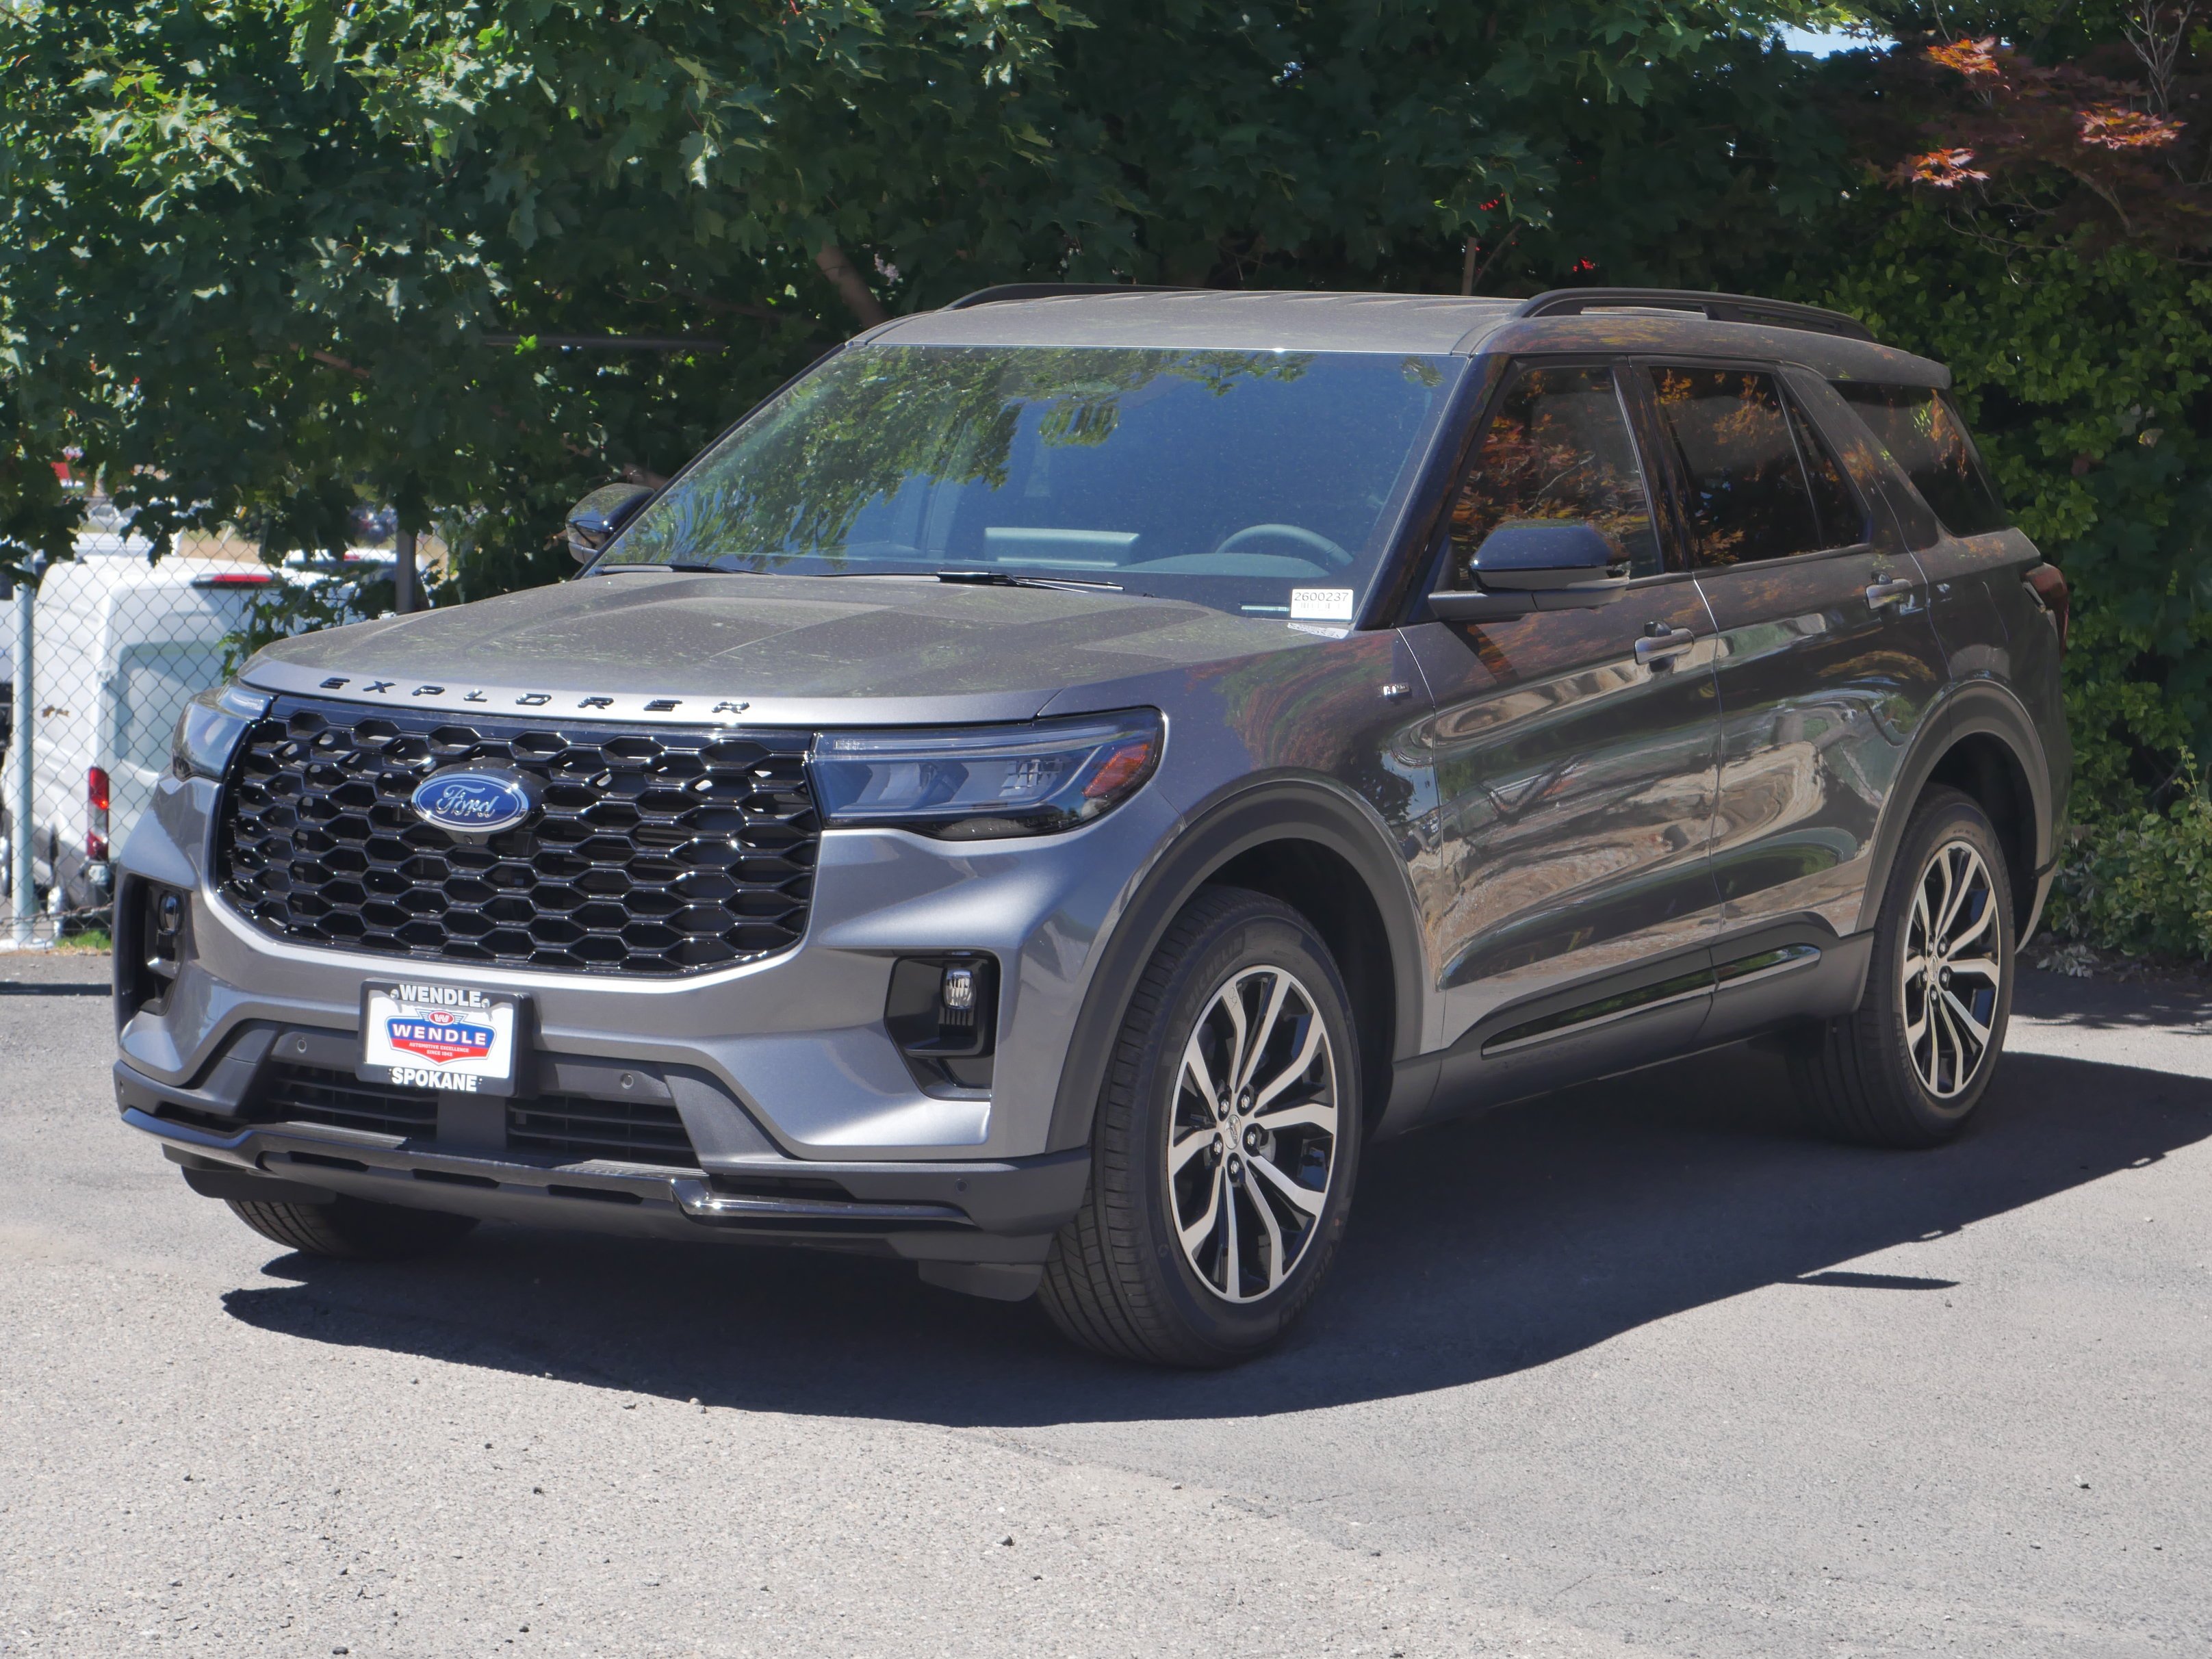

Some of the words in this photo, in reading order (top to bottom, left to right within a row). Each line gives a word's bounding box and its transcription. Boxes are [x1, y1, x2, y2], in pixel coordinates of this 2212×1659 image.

[1294, 592, 1348, 602] 2600237
[319, 677, 751, 715] EXPLORER
[435, 784, 500, 818] Ford
[400, 984, 481, 1007] WENDLE
[434, 1014, 449, 1023] W
[392, 1024, 486, 1045] WENDLE
[391, 1067, 477, 1092] SPOKANE
